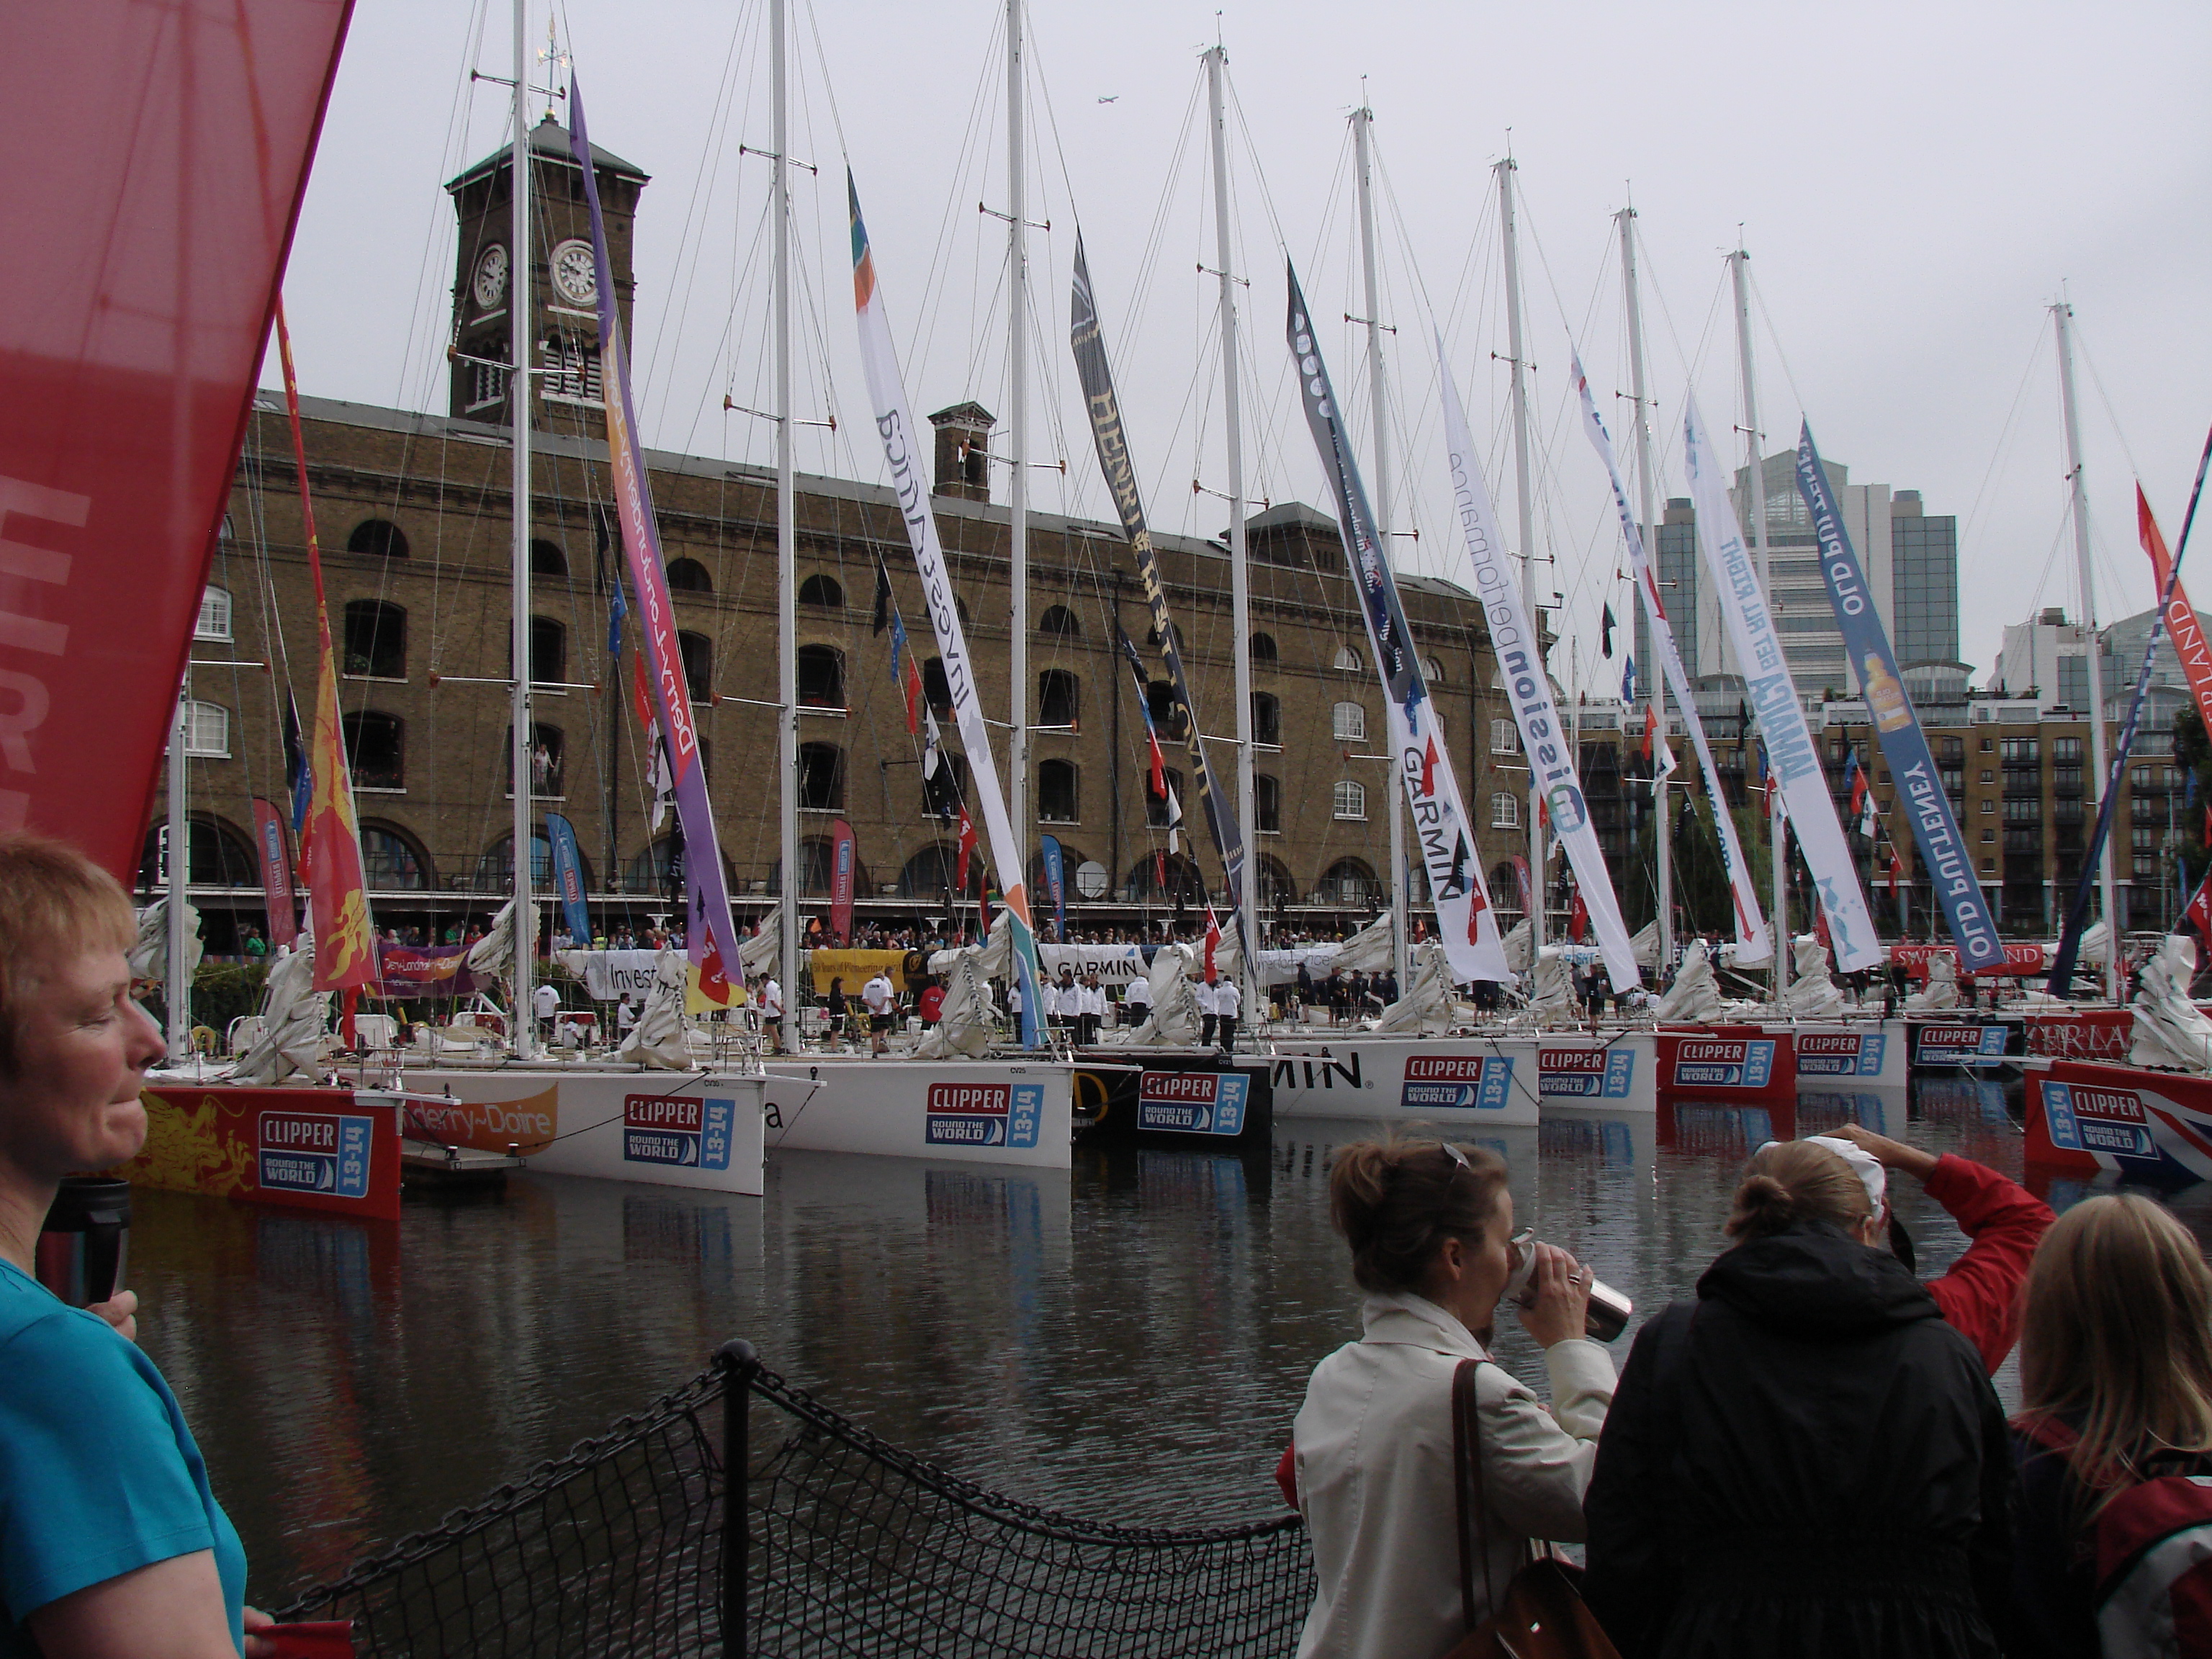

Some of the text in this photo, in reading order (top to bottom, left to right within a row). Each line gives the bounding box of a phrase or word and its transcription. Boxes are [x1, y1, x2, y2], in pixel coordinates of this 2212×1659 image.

[1091, 394, 1141, 530] HENRI
[1403, 746, 1461, 902] GARMIN
[1802, 1038, 1856, 1051] CLIPPER
[1924, 1030, 1978, 1043] CLIPPER
[1542, 1053, 1602, 1068] CLIPPER
[1683, 1045, 1742, 1058] CLIPPER
[1861, 1038, 1881, 1071] 13-14
[1410, 1060, 1477, 1077] CLIPPER
[1608, 1054, 1629, 1093] 13-14
[1748, 1046, 1768, 1082] 13-14
[1484, 1062, 1506, 1104] 13-14
[1681, 1072, 1724, 1082] WORLD
[1146, 1077, 1211, 1097] CLIPPER
[933, 1088, 1005, 1109] CLIPPER
[1219, 1081, 1241, 1128] 13-14
[1408, 1092, 1456, 1103] WORLD
[2074, 1092, 2140, 1117] CLIPPER
[629, 1100, 698, 1125] CLIPPER
[1013, 1090, 1036, 1141] 13-14
[1145, 1105, 1176, 1114] ROUND
[1145, 1113, 1192, 1125] WORLD
[2049, 1089, 2074, 1141] 13-14
[266, 1120, 334, 1146] CLIPPER
[629, 1135, 680, 1147] ROUND THE
[706, 1106, 728, 1163] 13-14
[932, 1128, 984, 1141] WORLD
[2083, 1125, 2133, 1138] ROUND THE
[2084, 1133, 2135, 1149] WORLD
[343, 1126, 364, 1187] 13-14
[629, 1143, 679, 1159] WORLD
[266, 1158, 316, 1171] ROUND THE
[266, 1166, 315, 1184] WORLD
